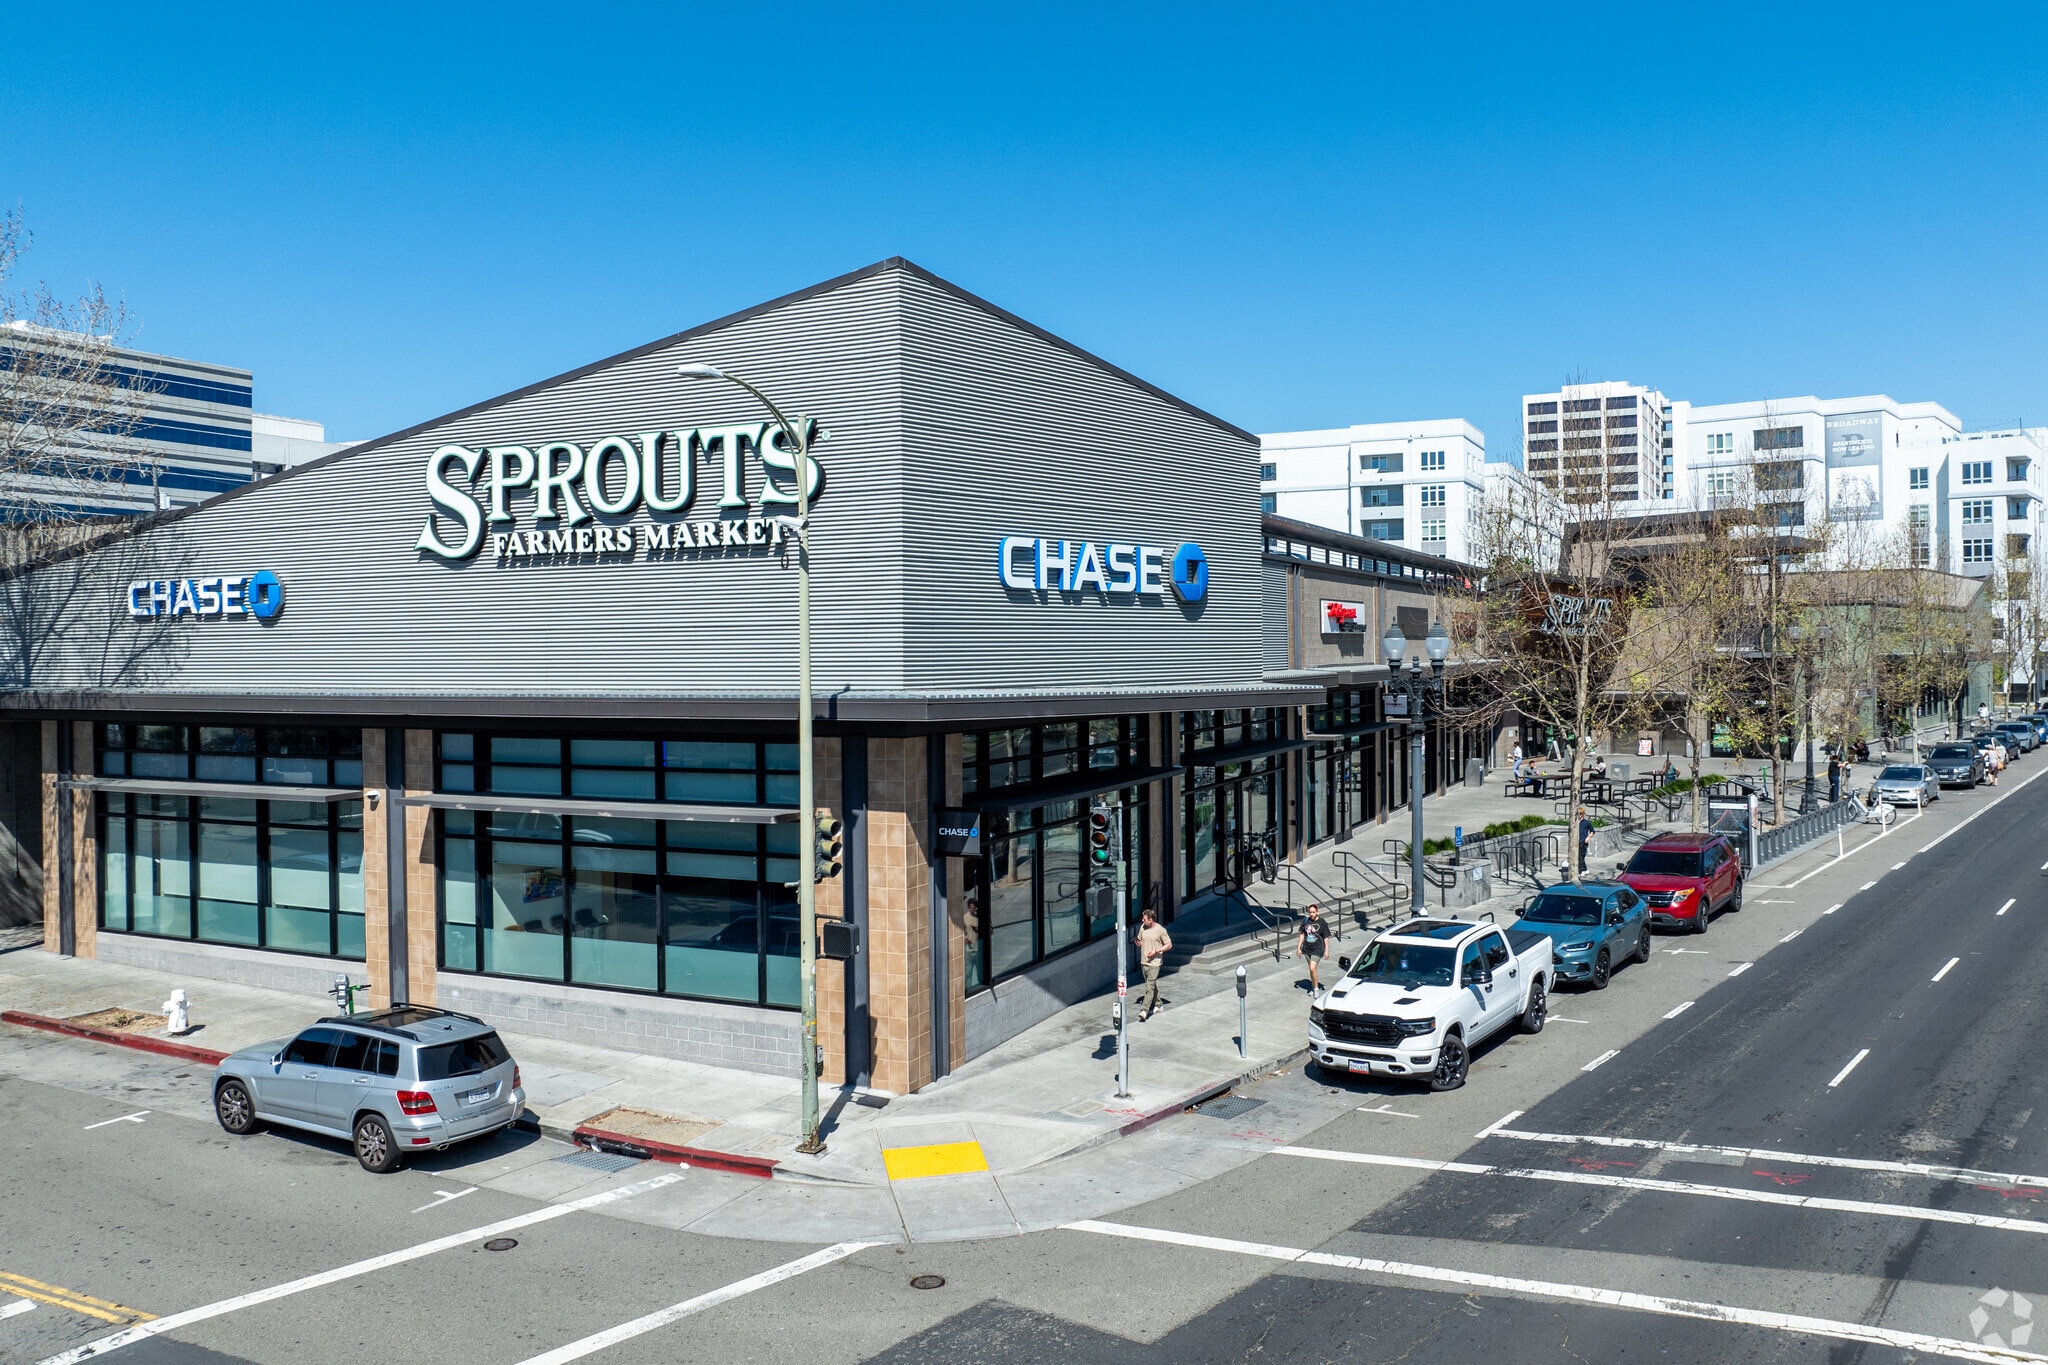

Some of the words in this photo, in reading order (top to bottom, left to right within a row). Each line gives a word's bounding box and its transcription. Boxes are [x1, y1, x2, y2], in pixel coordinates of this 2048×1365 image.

[1826, 417, 1880, 428] BROADWAY
[1832, 439, 1873, 447] APARTMENTS
[1848, 444, 1875, 452] LEASING
[492, 524, 633, 558] FARMERS
[642, 517, 786, 552] MARKET
[998, 536, 1165, 595] CHASE
[127, 576, 249, 617] CHASE
[939, 827, 969, 836] CHASE
